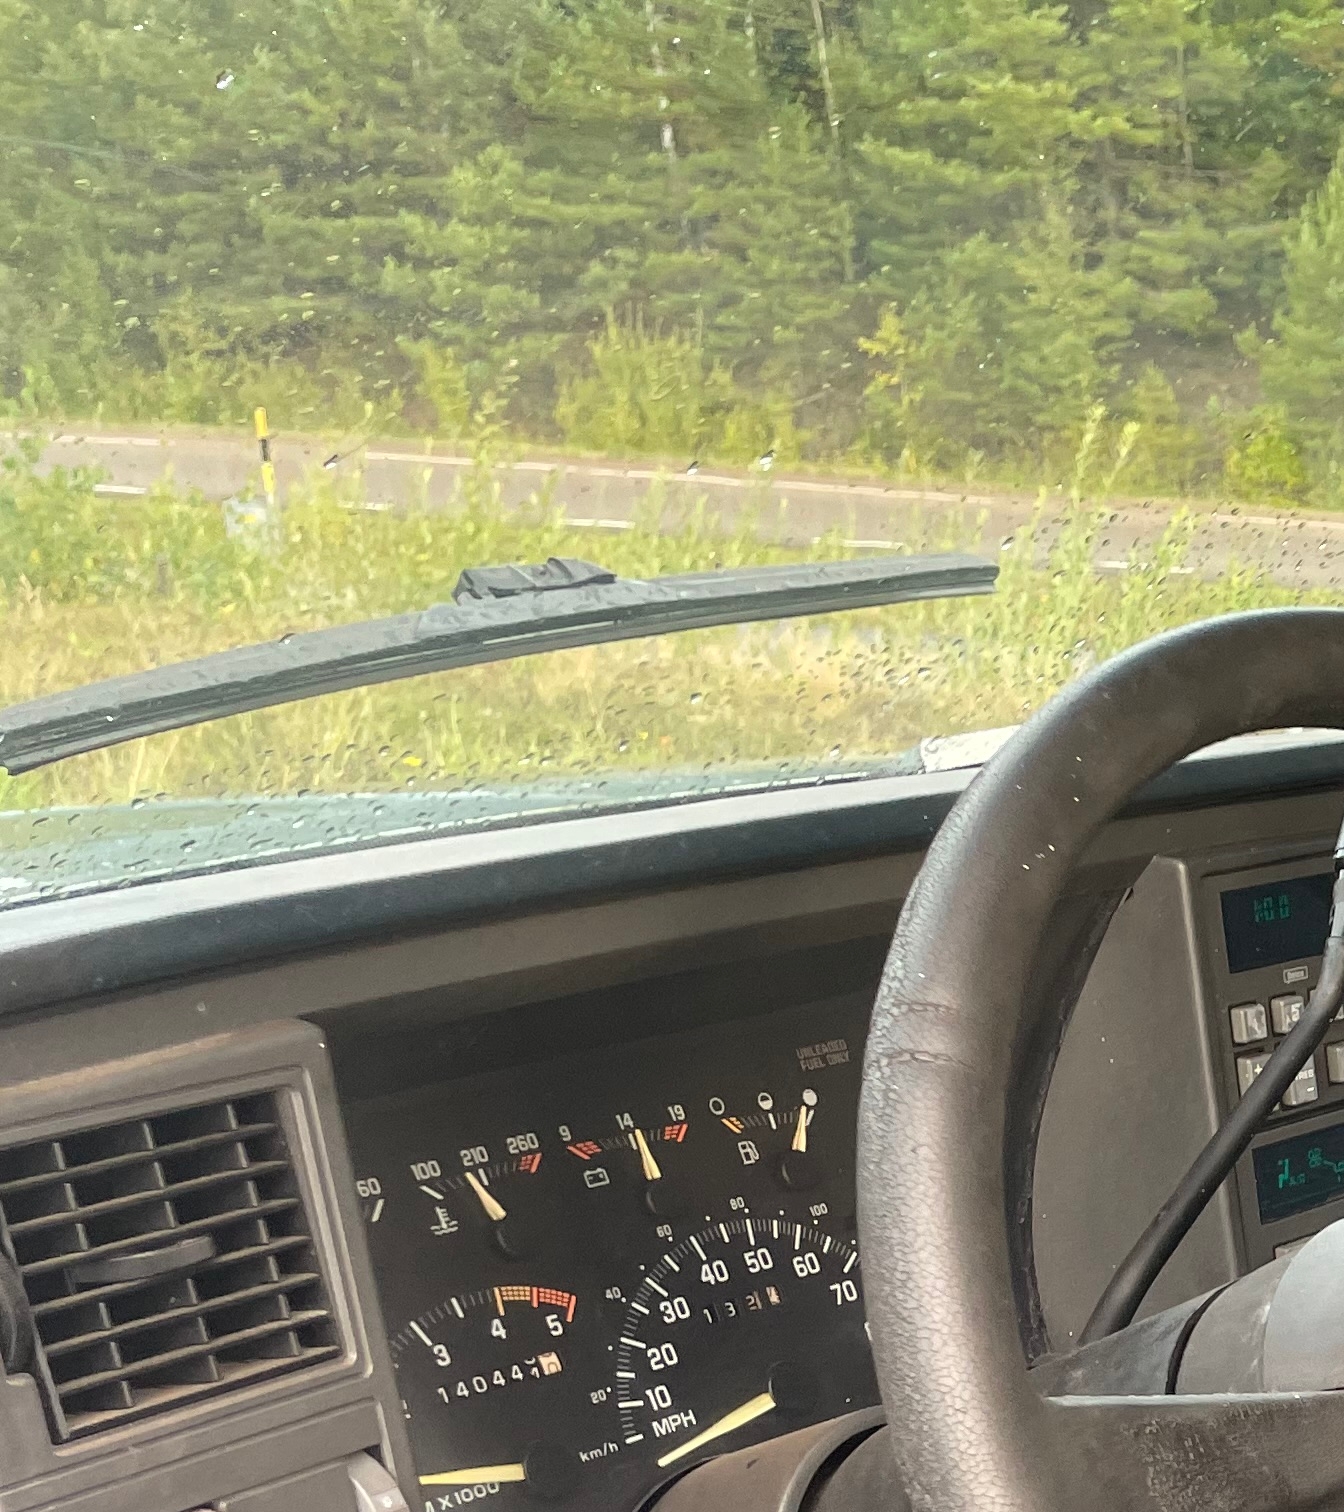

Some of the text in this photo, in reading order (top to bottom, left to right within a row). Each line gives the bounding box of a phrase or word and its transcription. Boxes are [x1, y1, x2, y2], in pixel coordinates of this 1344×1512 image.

[800, 1049, 850, 1072] FUEL ONLY
[558, 1104, 685, 1142] 9 14 19
[356, 1132, 539, 1198] 60 100 210 260
[729, 1196, 745, 1211] 80
[808, 1202, 828, 1217] 100
[656, 1224, 672, 1239] 60
[700, 1259, 729, 1285] 40
[743, 1247, 773, 1274] 50
[792, 1251, 821, 1278] 60
[605, 1286, 622, 1300] 40
[829, 1279, 858, 1306] 70
[659, 1296, 691, 1324] 30
[491, 1318, 507, 1340] 4
[545, 1313, 563, 1337] 5
[433, 1343, 452, 1367] 3
[647, 1342, 679, 1371] 20
[590, 1389, 607, 1404] 20
[645, 1384, 672, 1411] 10
[651, 1409, 697, 1438] MPH
[579, 1441, 619, 1463] km/h
